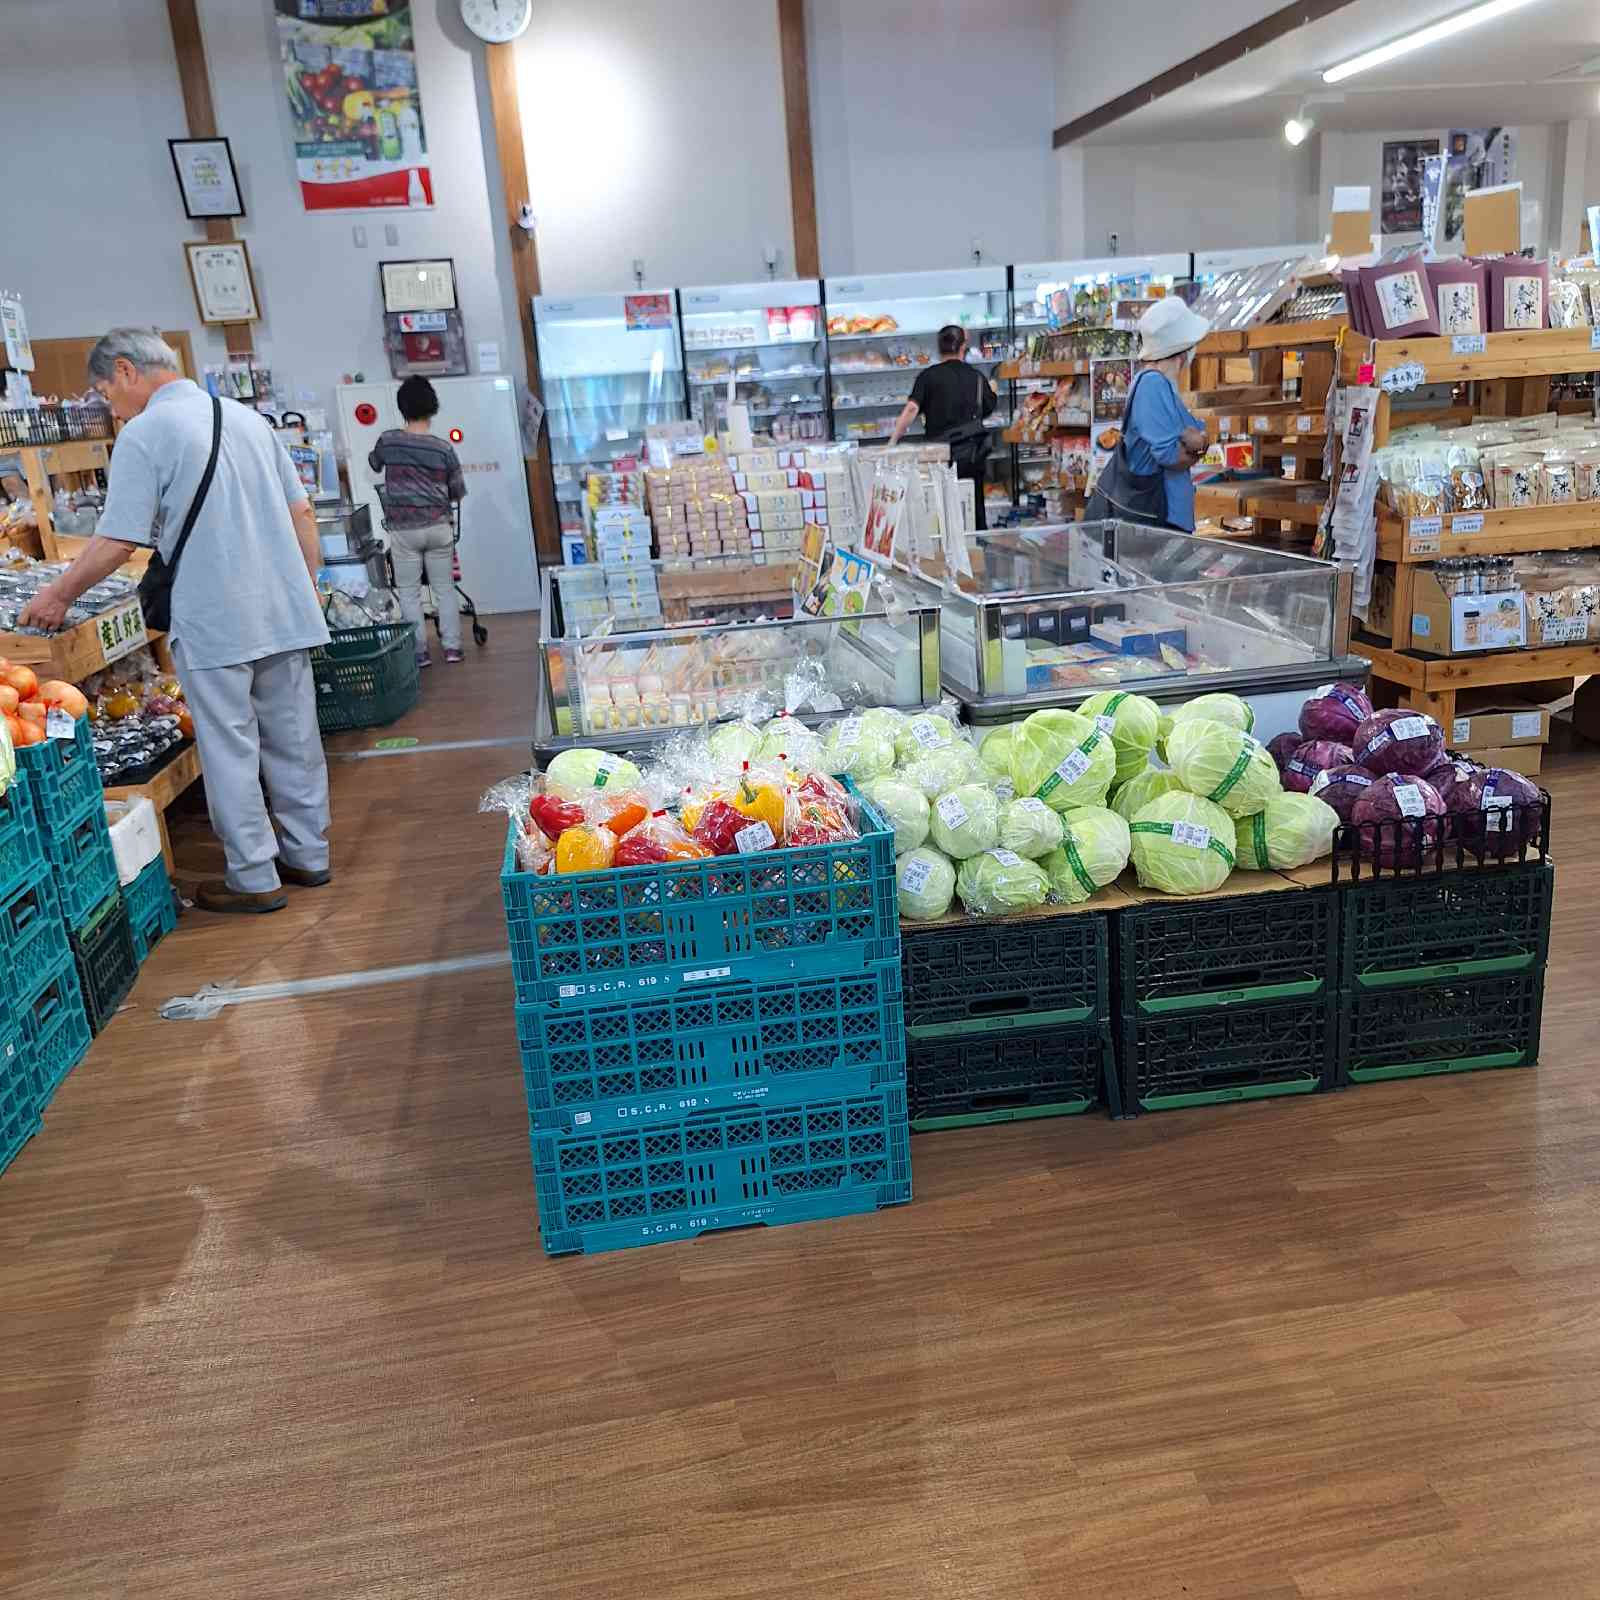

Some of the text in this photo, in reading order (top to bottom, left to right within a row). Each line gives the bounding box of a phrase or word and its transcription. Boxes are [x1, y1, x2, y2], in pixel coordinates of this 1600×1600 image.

[589, 980, 632, 993] S.C.R.
[638, 976, 657, 986] 619
[630, 1103, 672, 1116] S.C.R.
[642, 1223, 683, 1236] S.C.R.
[689, 1218, 707, 1228] 619
